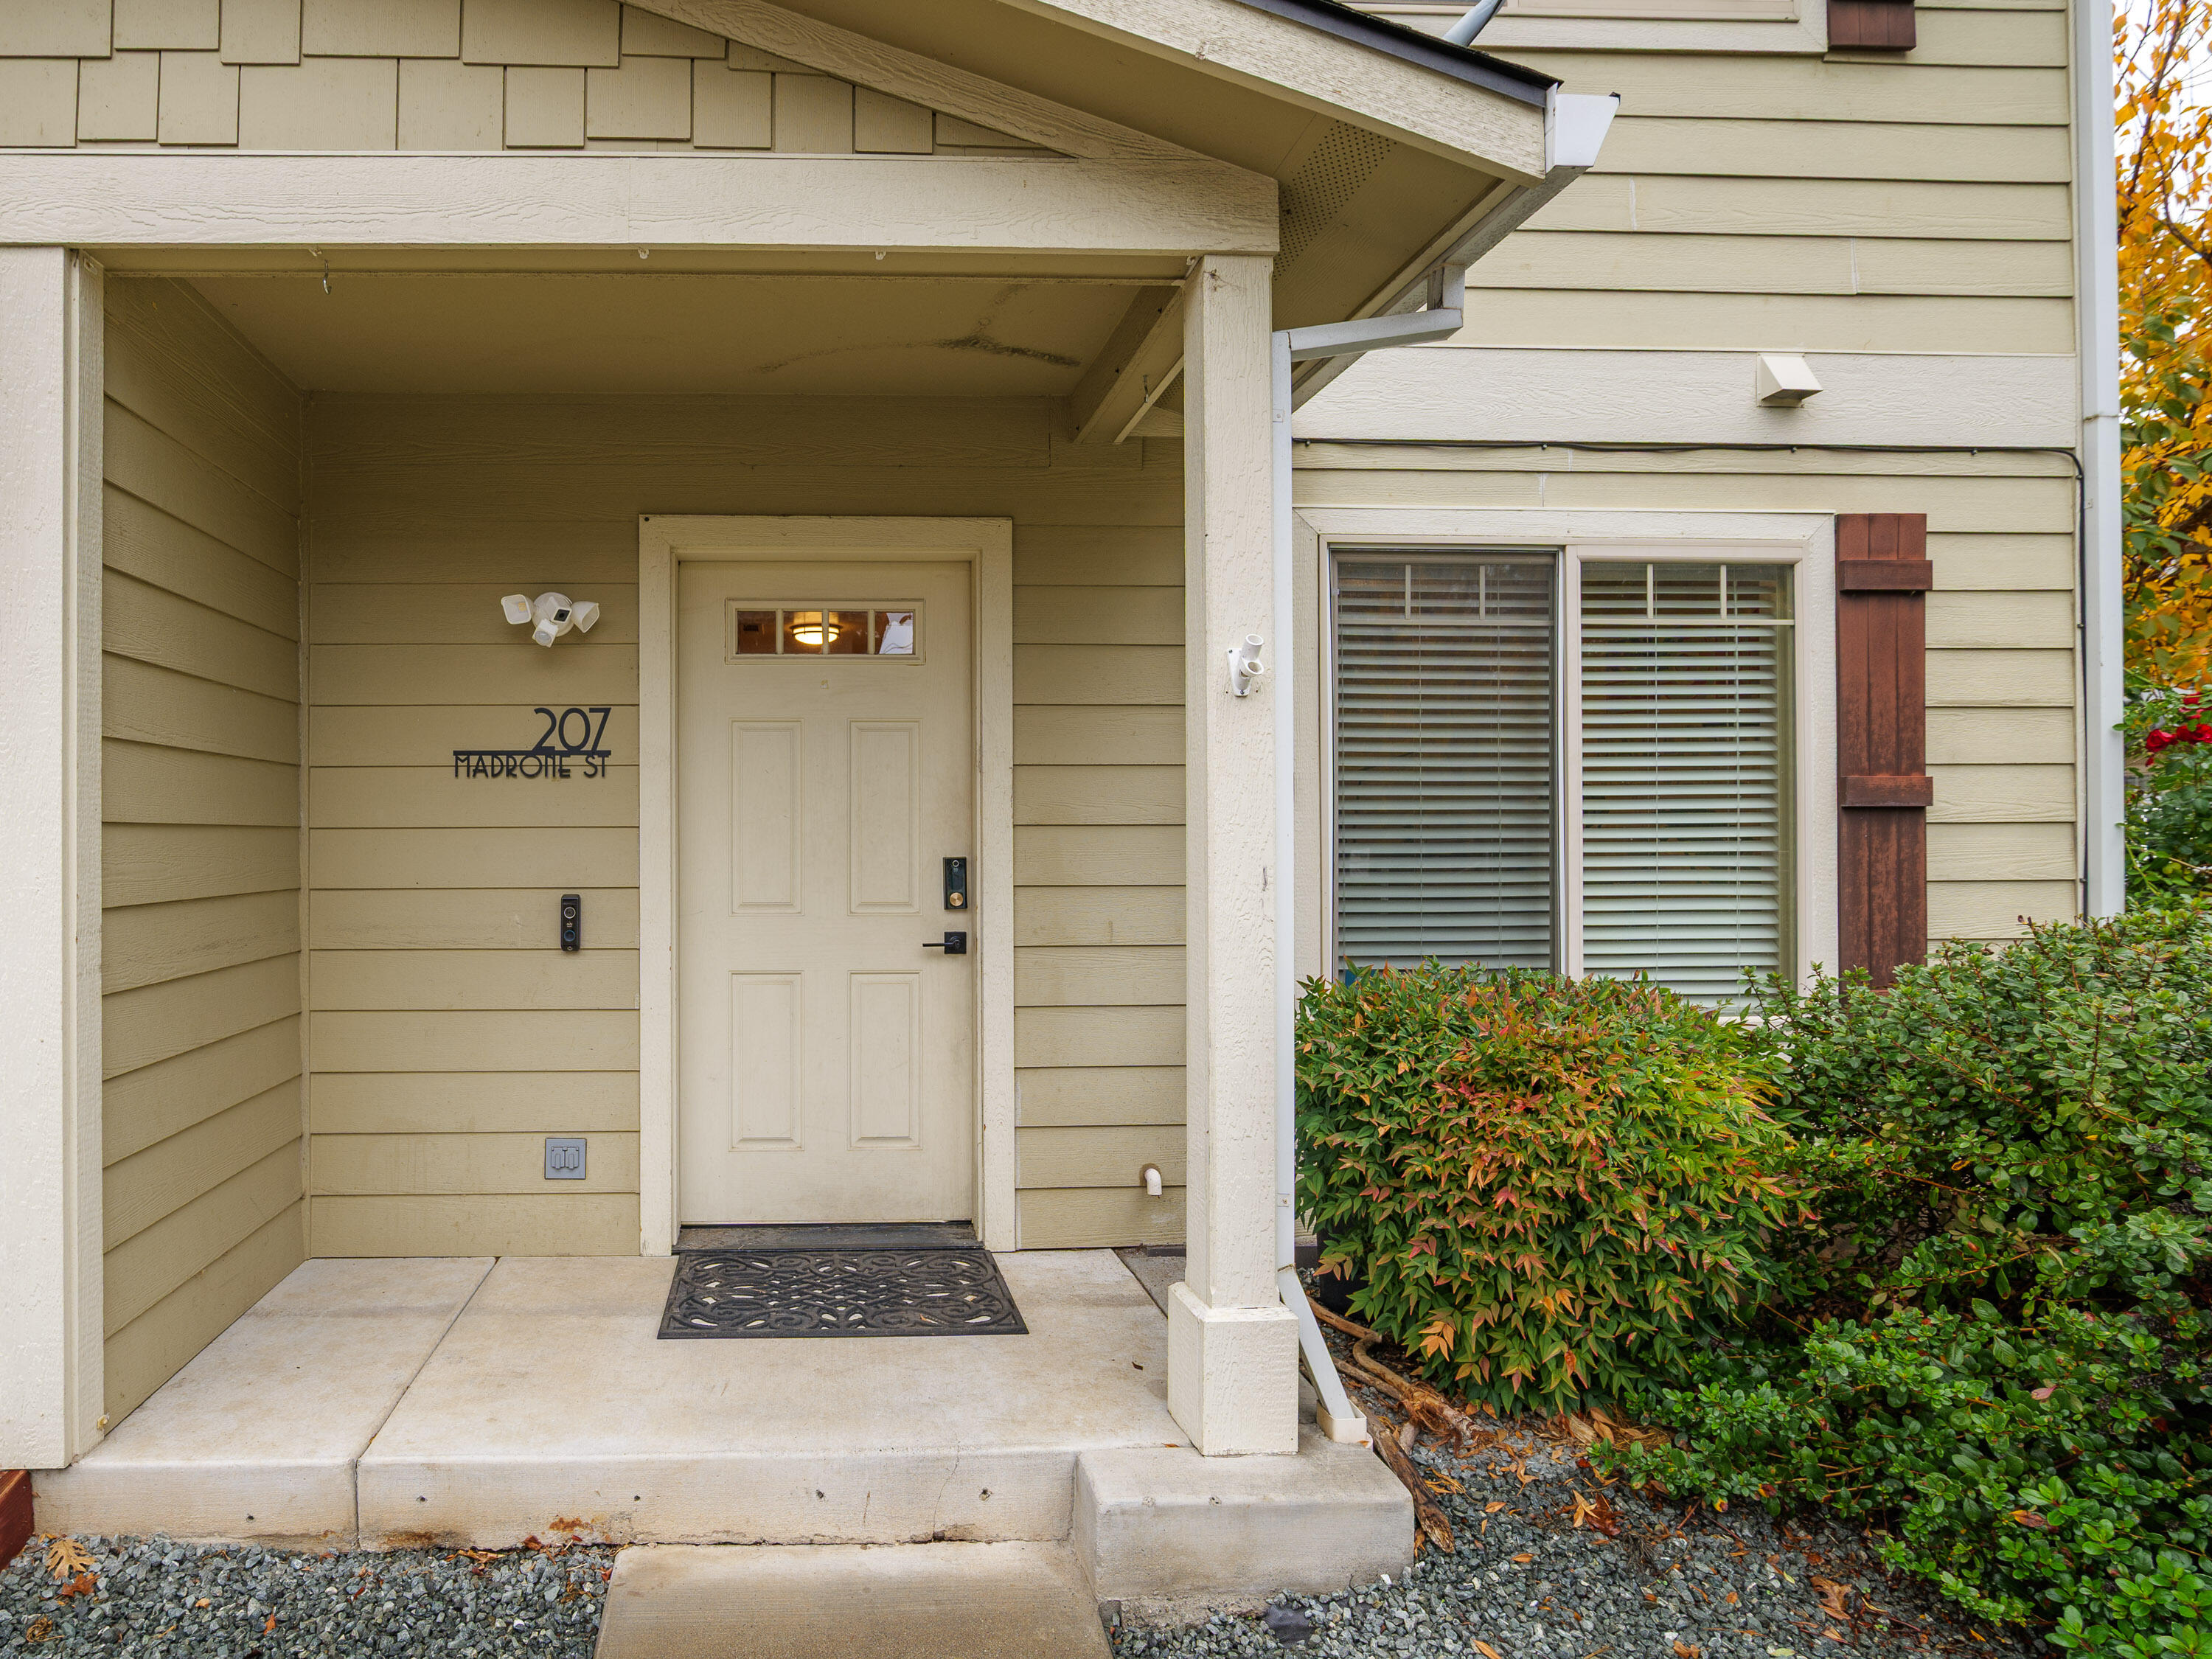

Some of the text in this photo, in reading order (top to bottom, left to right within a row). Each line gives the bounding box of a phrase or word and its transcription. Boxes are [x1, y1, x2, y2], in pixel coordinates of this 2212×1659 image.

[532, 707, 612, 752] 207
[454, 754, 610, 779] MADRONE ST
